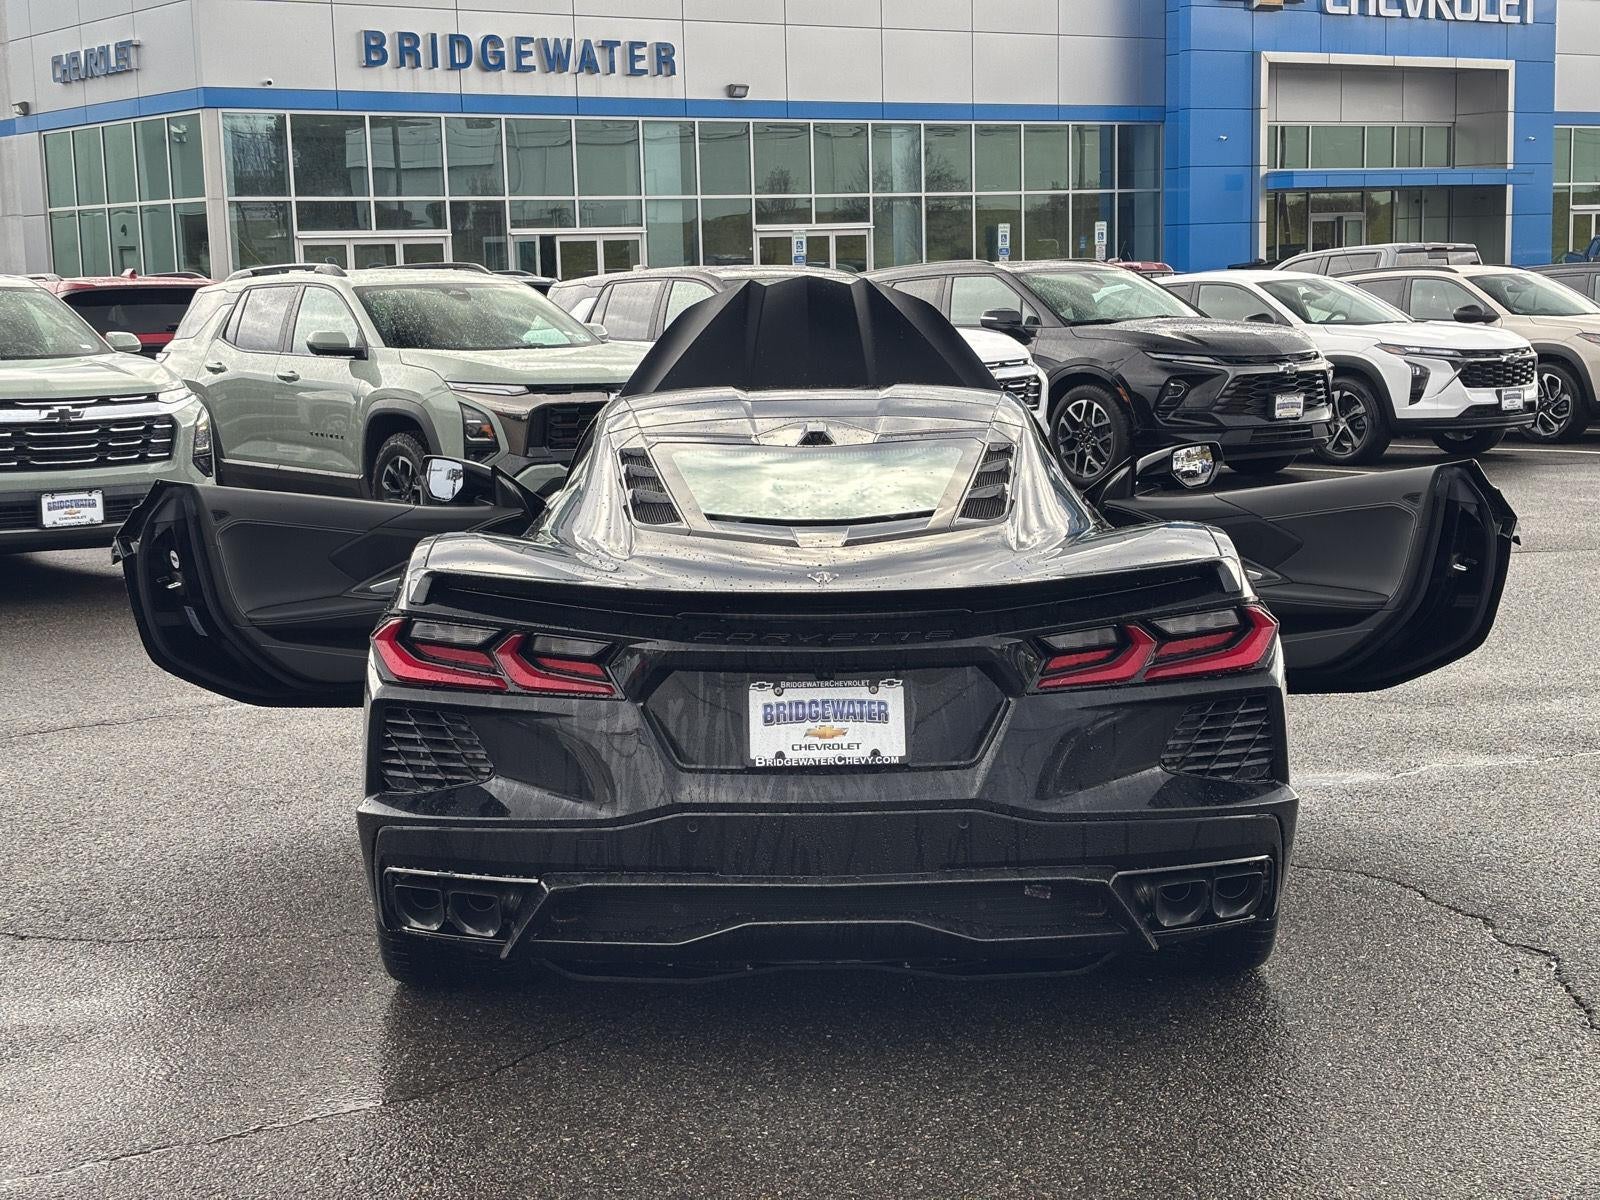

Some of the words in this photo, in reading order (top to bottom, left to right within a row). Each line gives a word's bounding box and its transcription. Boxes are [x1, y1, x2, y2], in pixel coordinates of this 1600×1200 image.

[51, 39, 140, 83] CHEVROLET
[360, 29, 677, 77] BRIDGEWATER
[692, 630, 954, 643] CORVETTE
[762, 698, 890, 726] BRIDGEWATER
[791, 742, 862, 751] CHEVROLET
